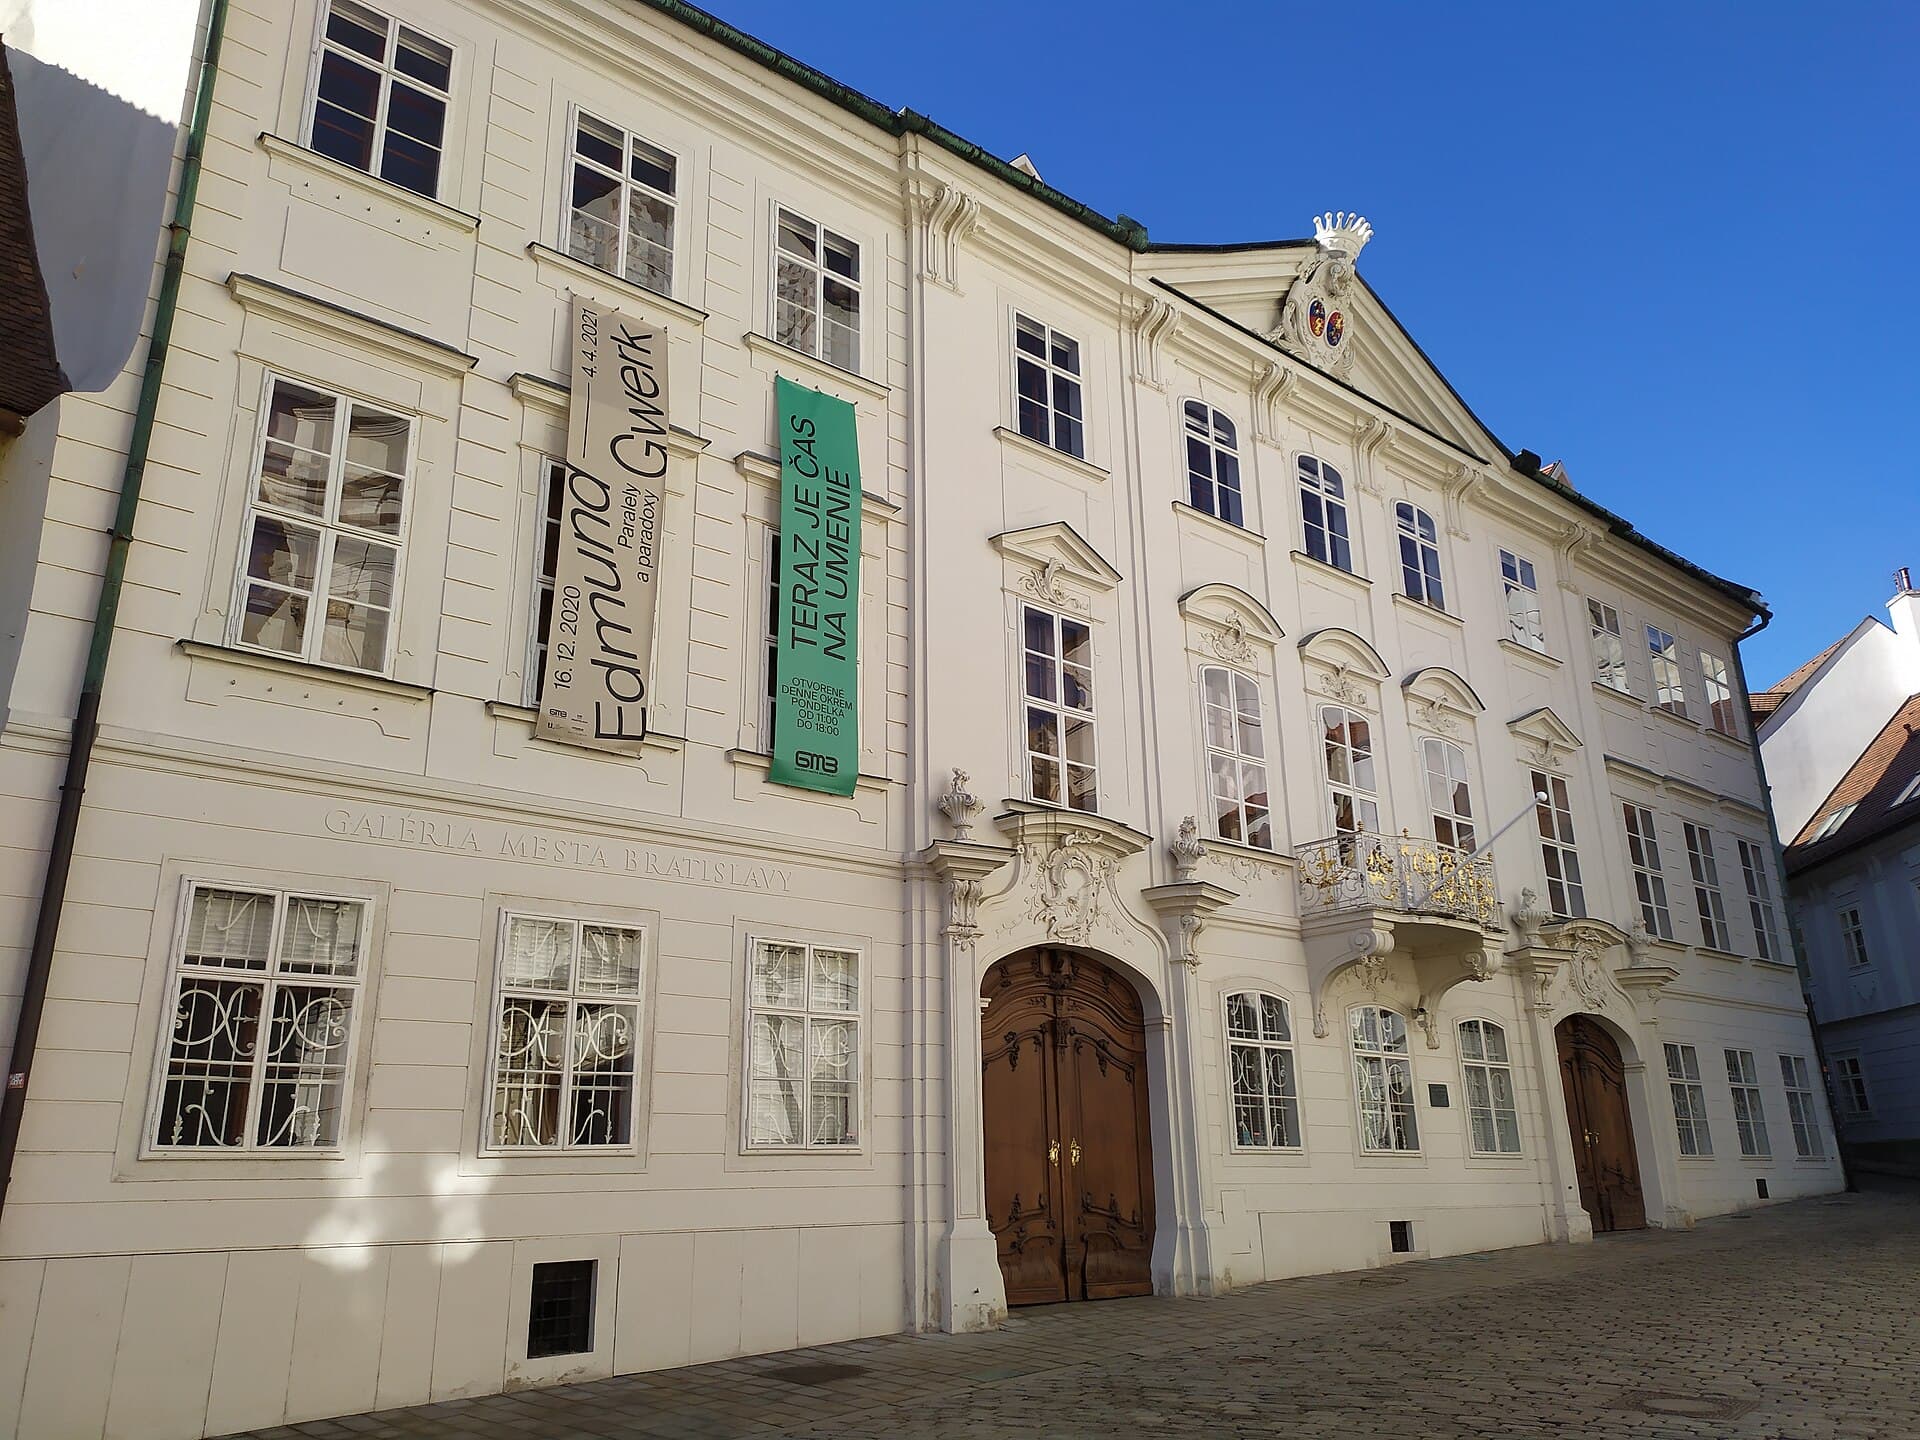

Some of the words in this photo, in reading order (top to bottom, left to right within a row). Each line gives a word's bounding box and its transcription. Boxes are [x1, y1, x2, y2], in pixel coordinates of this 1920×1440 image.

[581, 308, 598, 346] 2021
[788, 414, 820, 479] ČAS
[617, 482, 642, 549] Paralely
[638, 488, 660, 569] paradoxy
[794, 484, 820, 529] JE
[566, 461, 647, 741] Edmund
[609, 323, 668, 478] Gwerk
[824, 465, 851, 600] UMENIE
[637, 571, 650, 583] a
[791, 533, 820, 650] TERAZ
[559, 585, 581, 636] 2020
[557, 641, 577, 661] 12.
[823, 612, 847, 661] NA
[553, 668, 573, 689] 16.
[782, 685, 818, 701] DENNE
[819, 694, 853, 711] OKREM
[791, 697, 845, 718] PONDELKA
[797, 719, 813, 730] DO
[815, 723, 840, 736] 18:00
[799, 709, 814, 720] OD
[816, 713, 838, 726] 11:00
[324, 809, 482, 852] GALÉRIA
[499, 831, 609, 869] MESTA
[624, 848, 793, 892] BRATISLAVY
